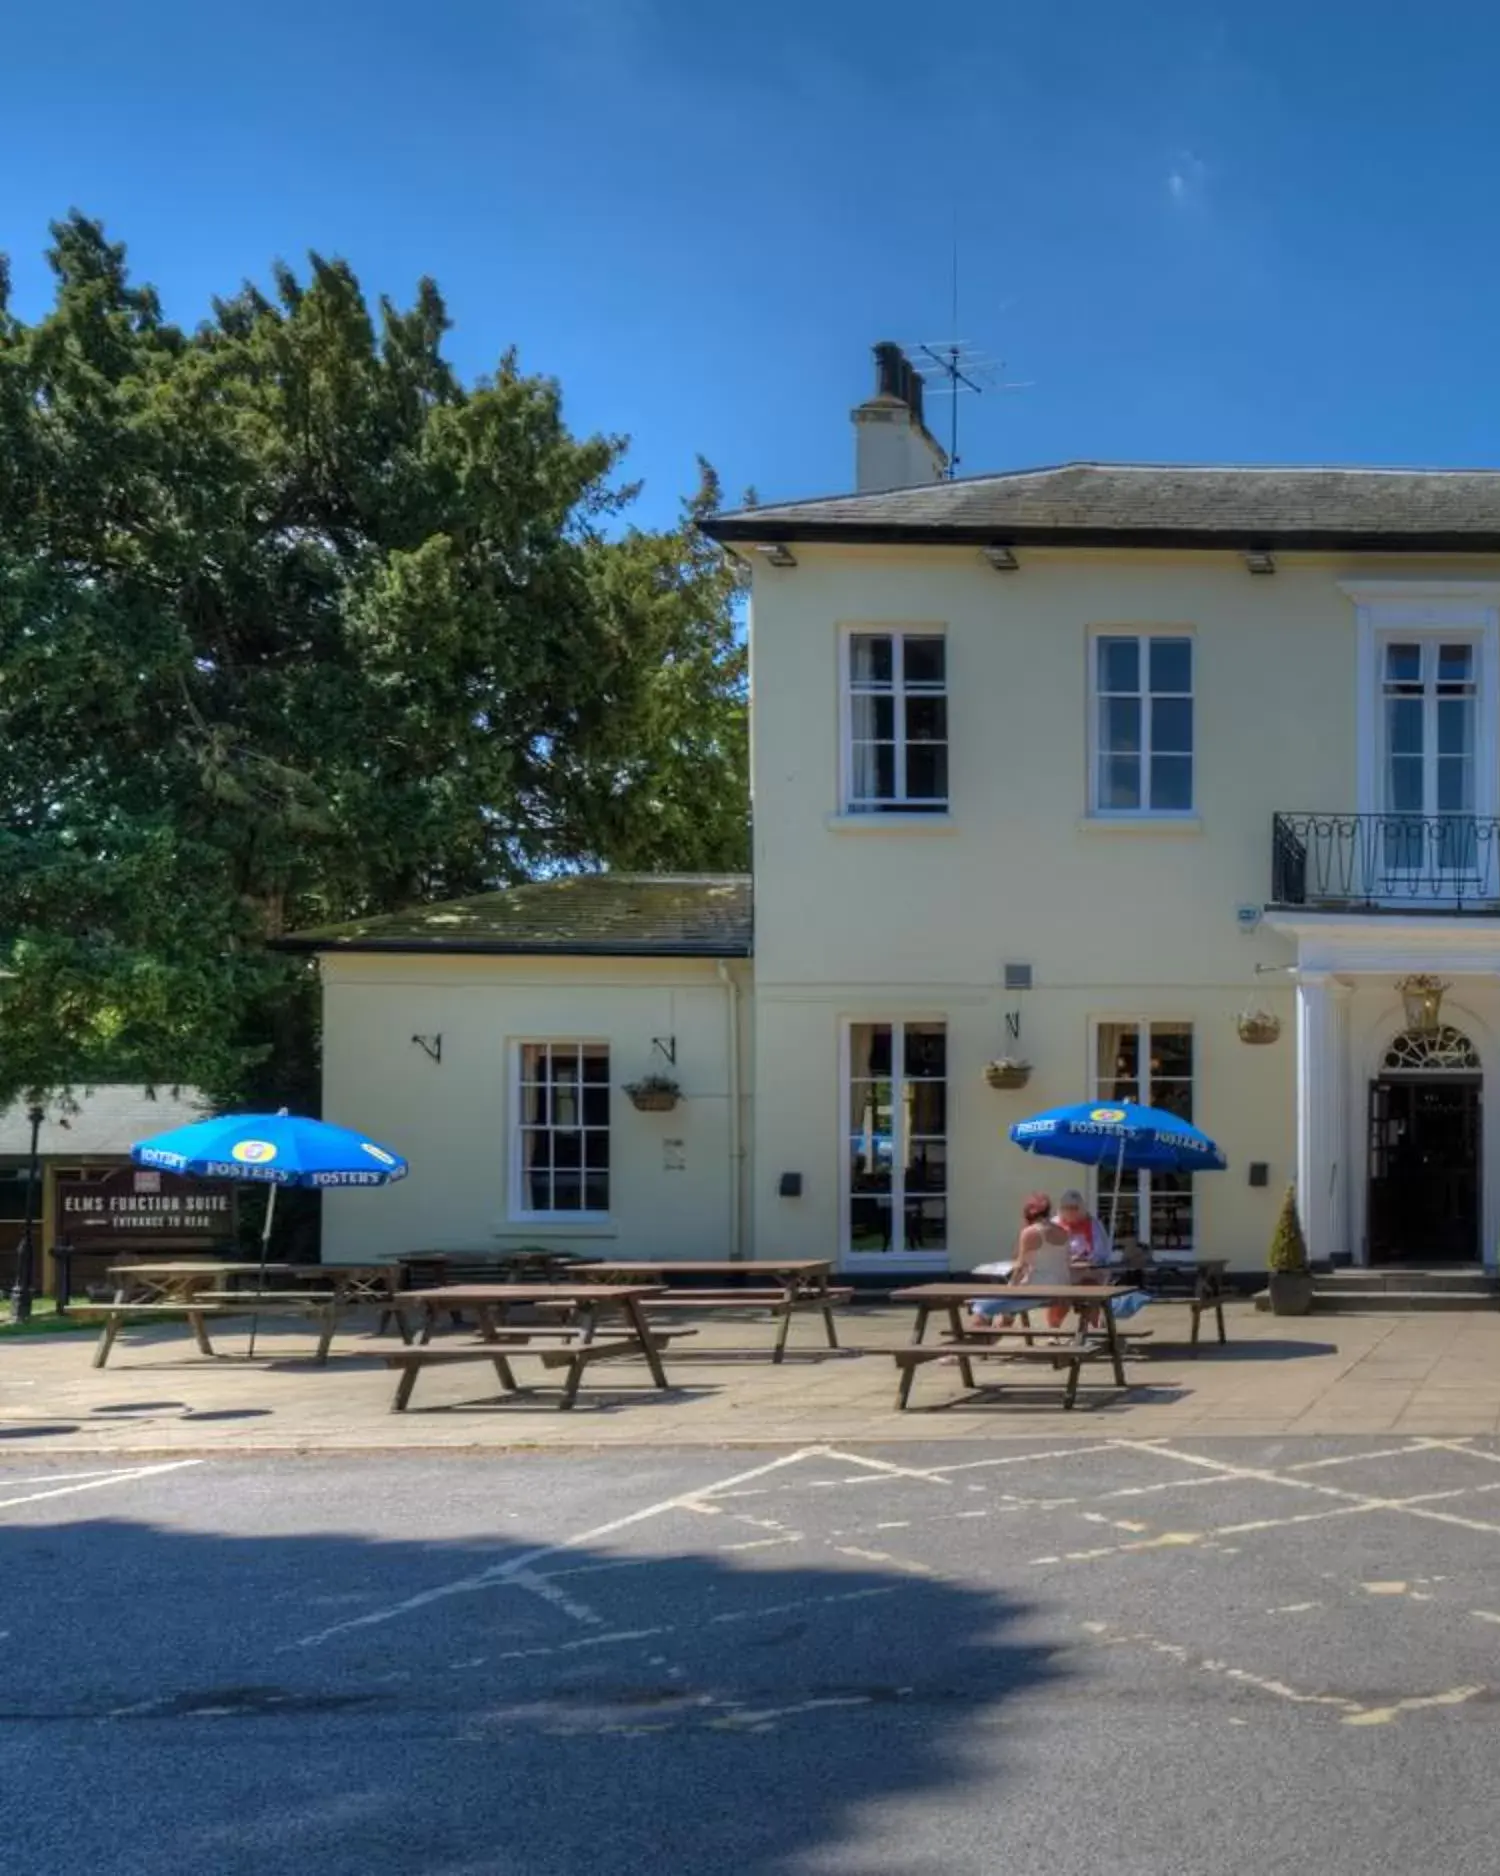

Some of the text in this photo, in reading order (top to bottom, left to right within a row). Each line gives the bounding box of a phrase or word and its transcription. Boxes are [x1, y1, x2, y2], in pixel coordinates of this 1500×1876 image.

[1068, 1120, 1137, 1139] FOSTER'S
[206, 1161, 289, 1182] FOSTER'S
[311, 1171, 381, 1186] FOSTER'S
[64, 1196, 227, 1211] ELMS FUNCTION SUITE
[113, 1215, 210, 1228] ENTRANCE TO REAR
